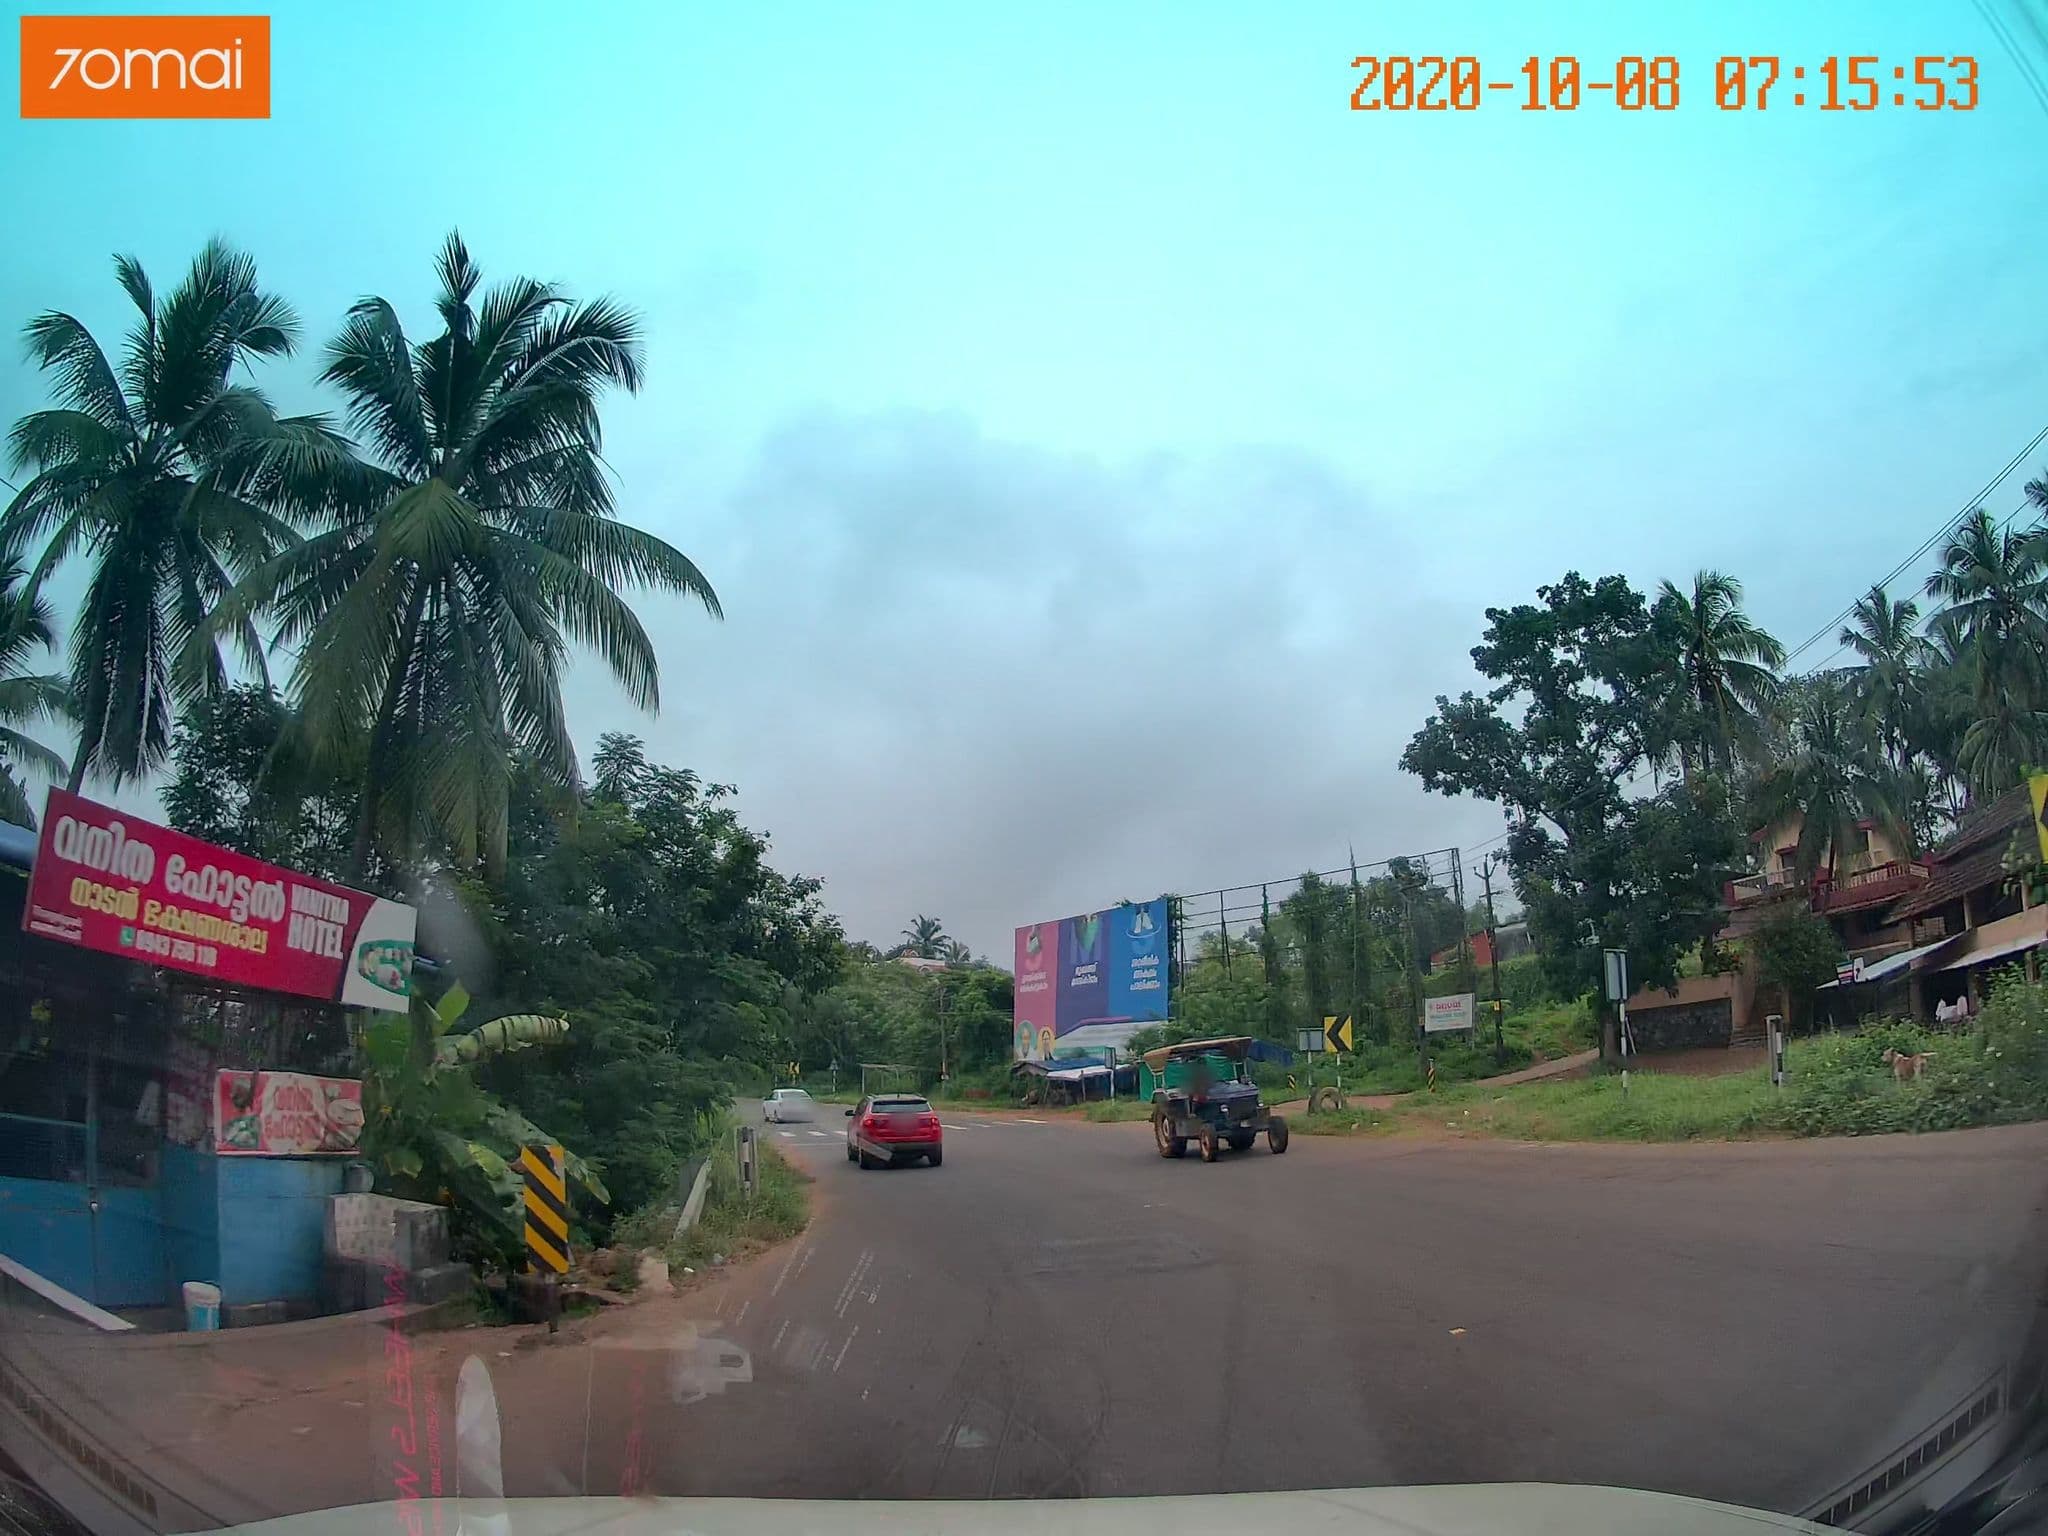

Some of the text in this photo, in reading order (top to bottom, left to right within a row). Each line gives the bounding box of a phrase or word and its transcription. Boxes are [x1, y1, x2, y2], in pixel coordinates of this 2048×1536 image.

[53, 815, 155, 885] വനിത
[291, 883, 349, 925] VANITHA
[287, 912, 344, 960] HOTEL
